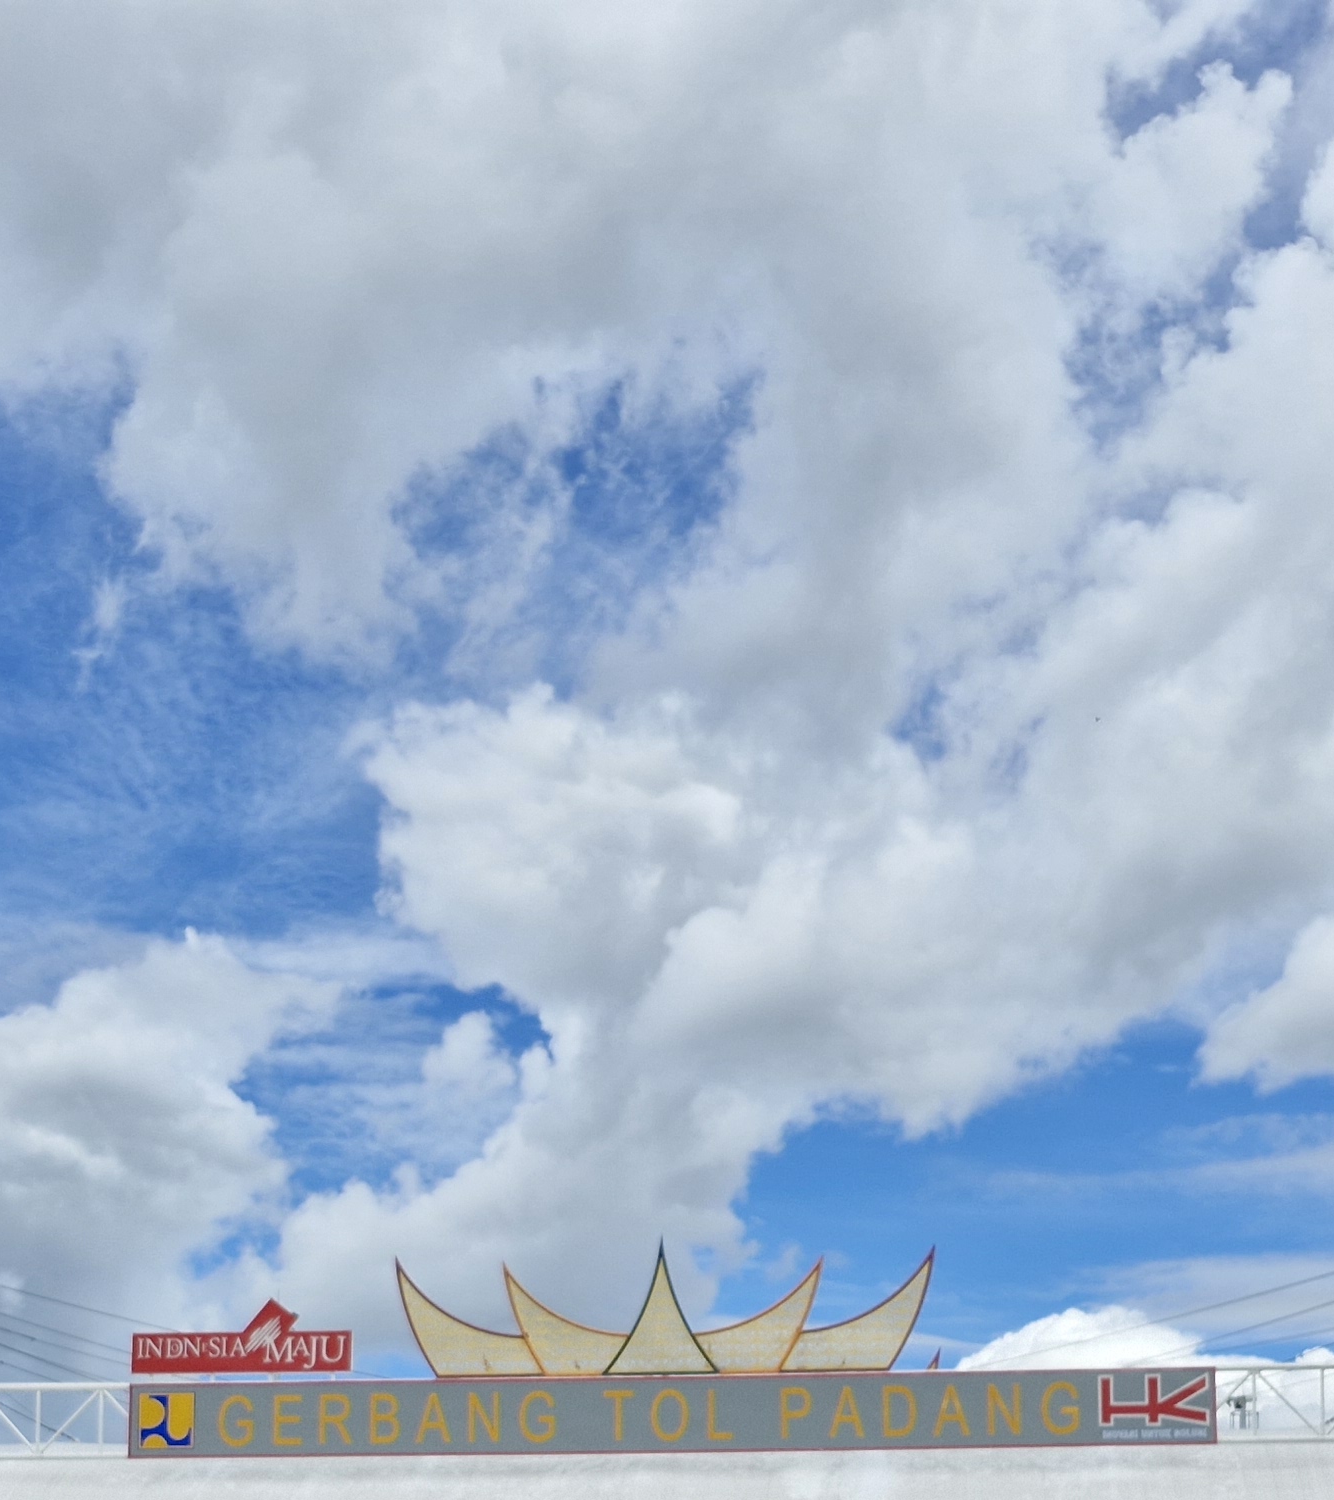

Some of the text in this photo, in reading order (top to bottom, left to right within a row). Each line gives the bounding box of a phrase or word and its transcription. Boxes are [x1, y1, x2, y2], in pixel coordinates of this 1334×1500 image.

[263, 1335, 347, 1369] MAJU
[218, 1381, 1081, 1447] GERBANG TOL PADANG
